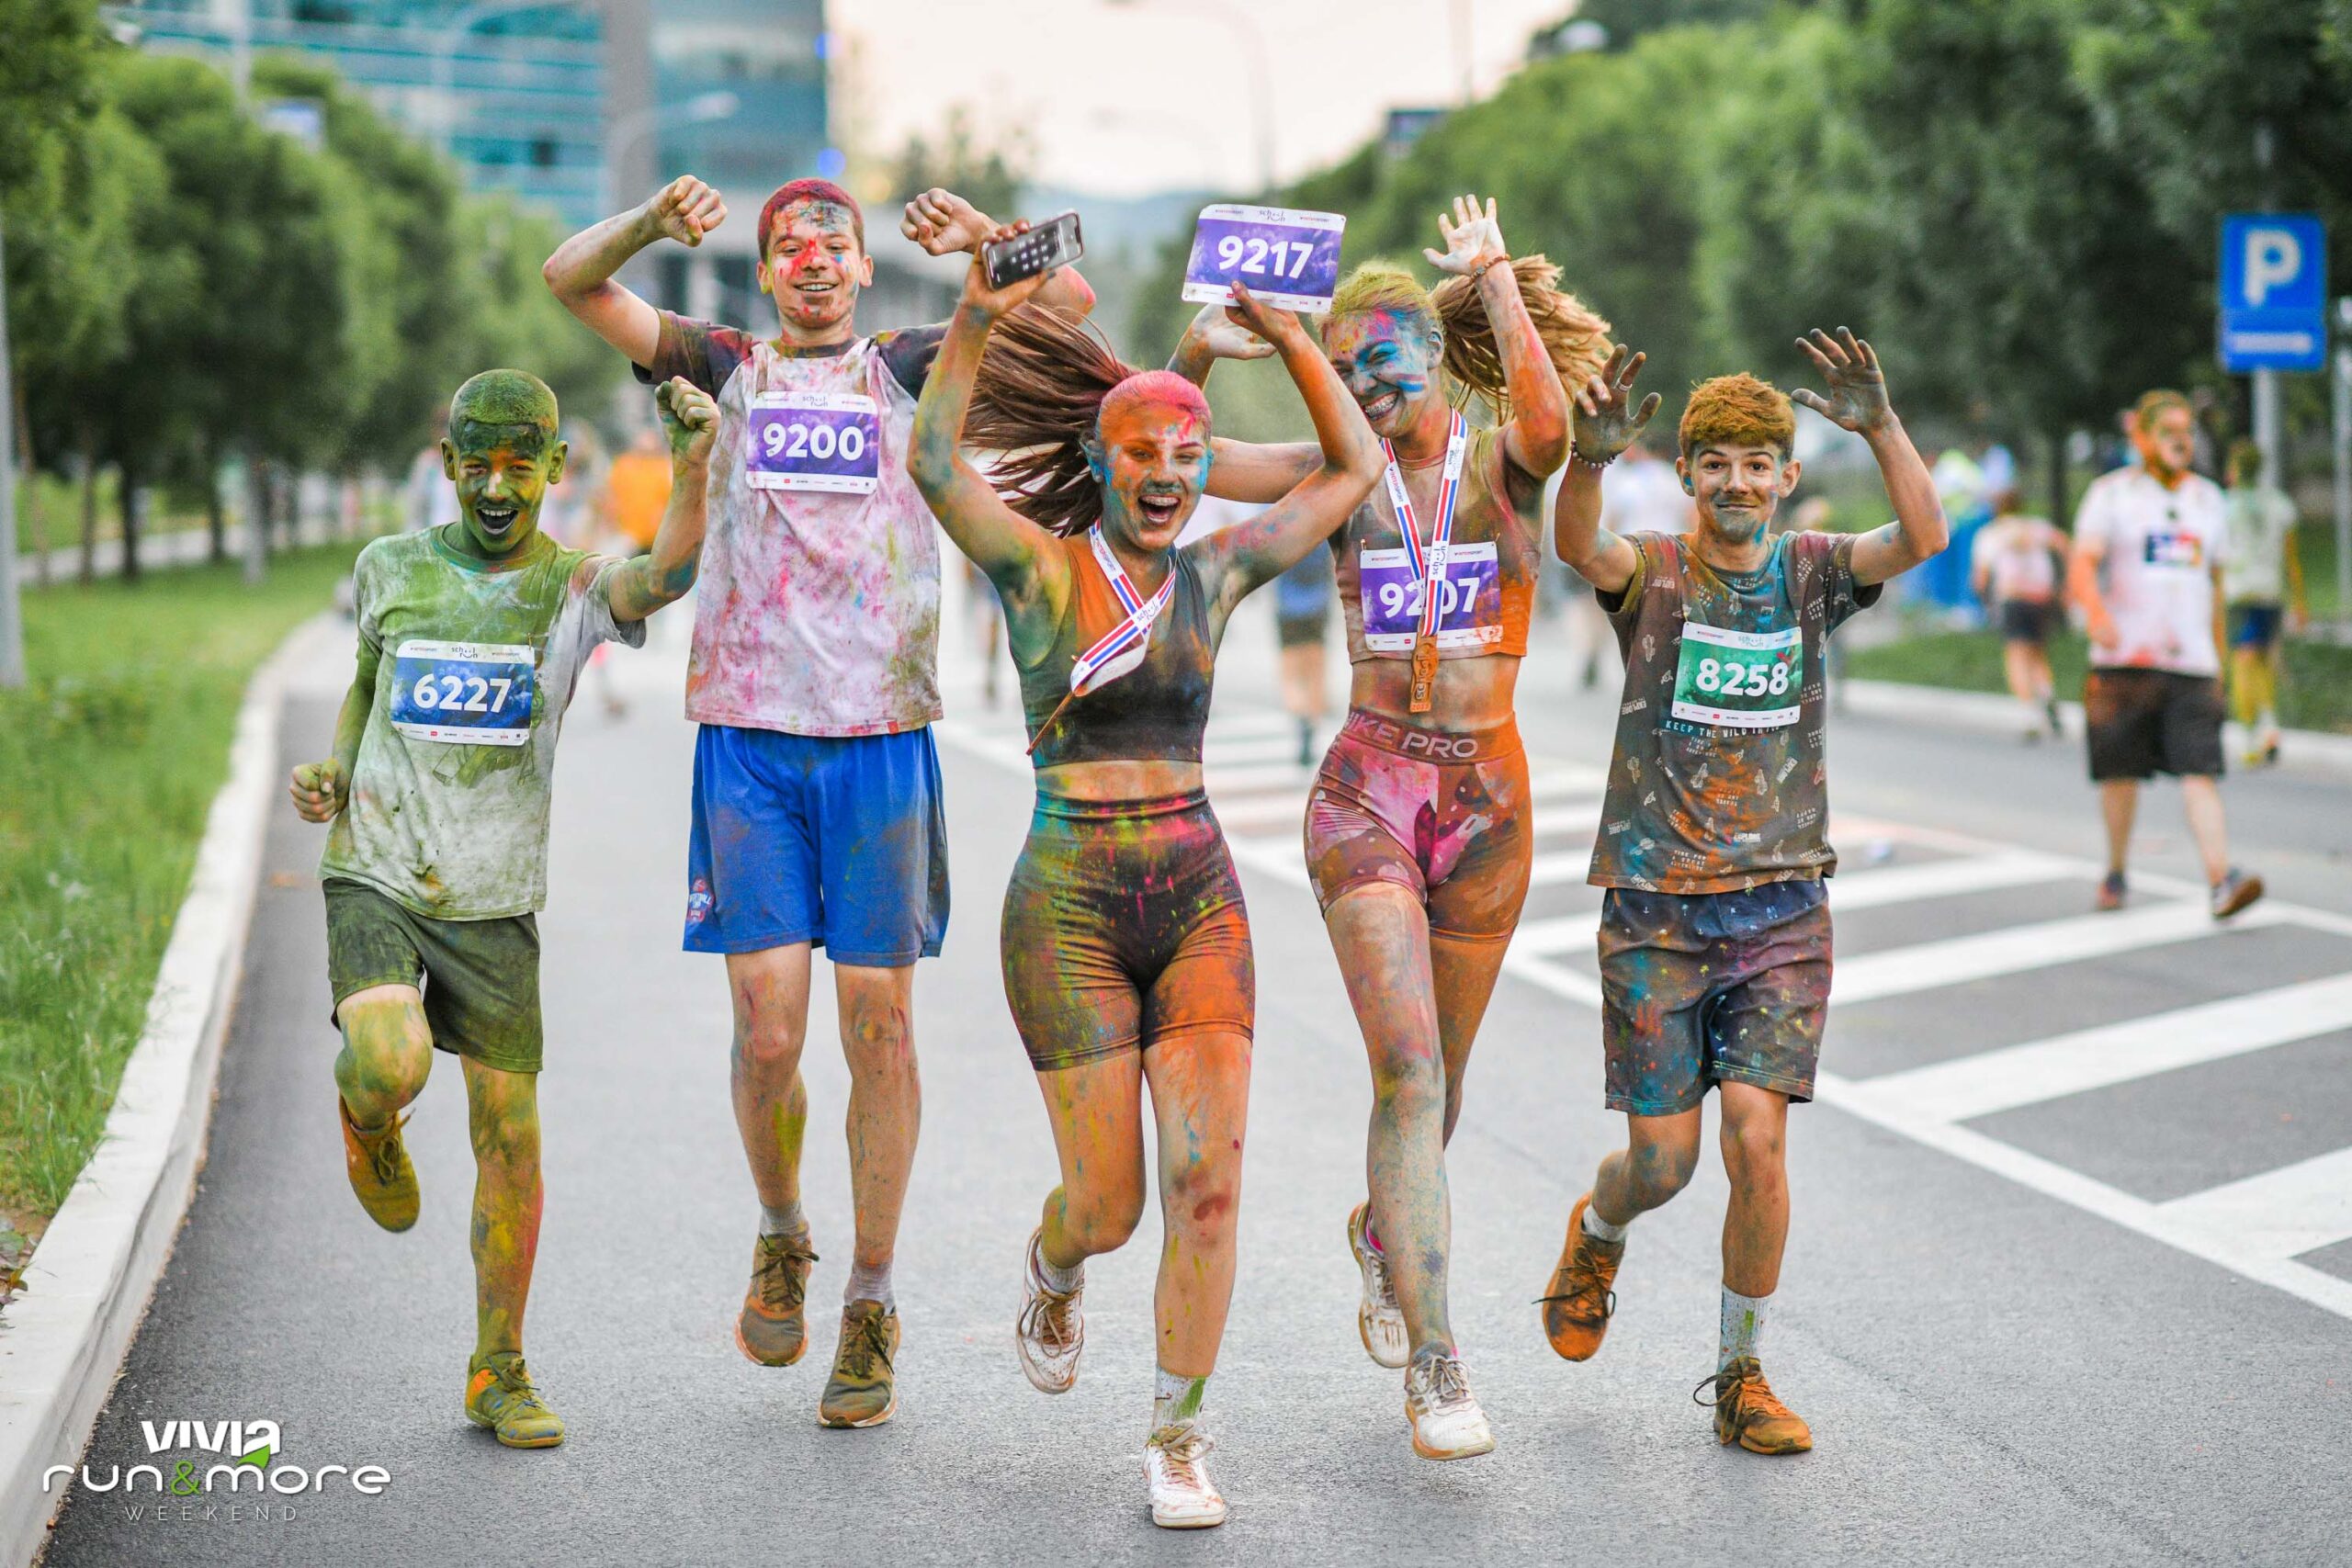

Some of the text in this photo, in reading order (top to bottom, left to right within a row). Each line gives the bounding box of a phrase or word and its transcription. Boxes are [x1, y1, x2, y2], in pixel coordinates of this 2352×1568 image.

[1217, 235, 1314, 279] 9217
[2245, 231, 2301, 303] P
[763, 423, 865, 461] 9200
[413, 673, 512, 714] 6227
[1696, 658, 1789, 697] 8258
[1401, 731, 1479, 758] PRO
[1666, 720, 1694, 733] KEEP
[1700, 728, 1717, 739] THE
